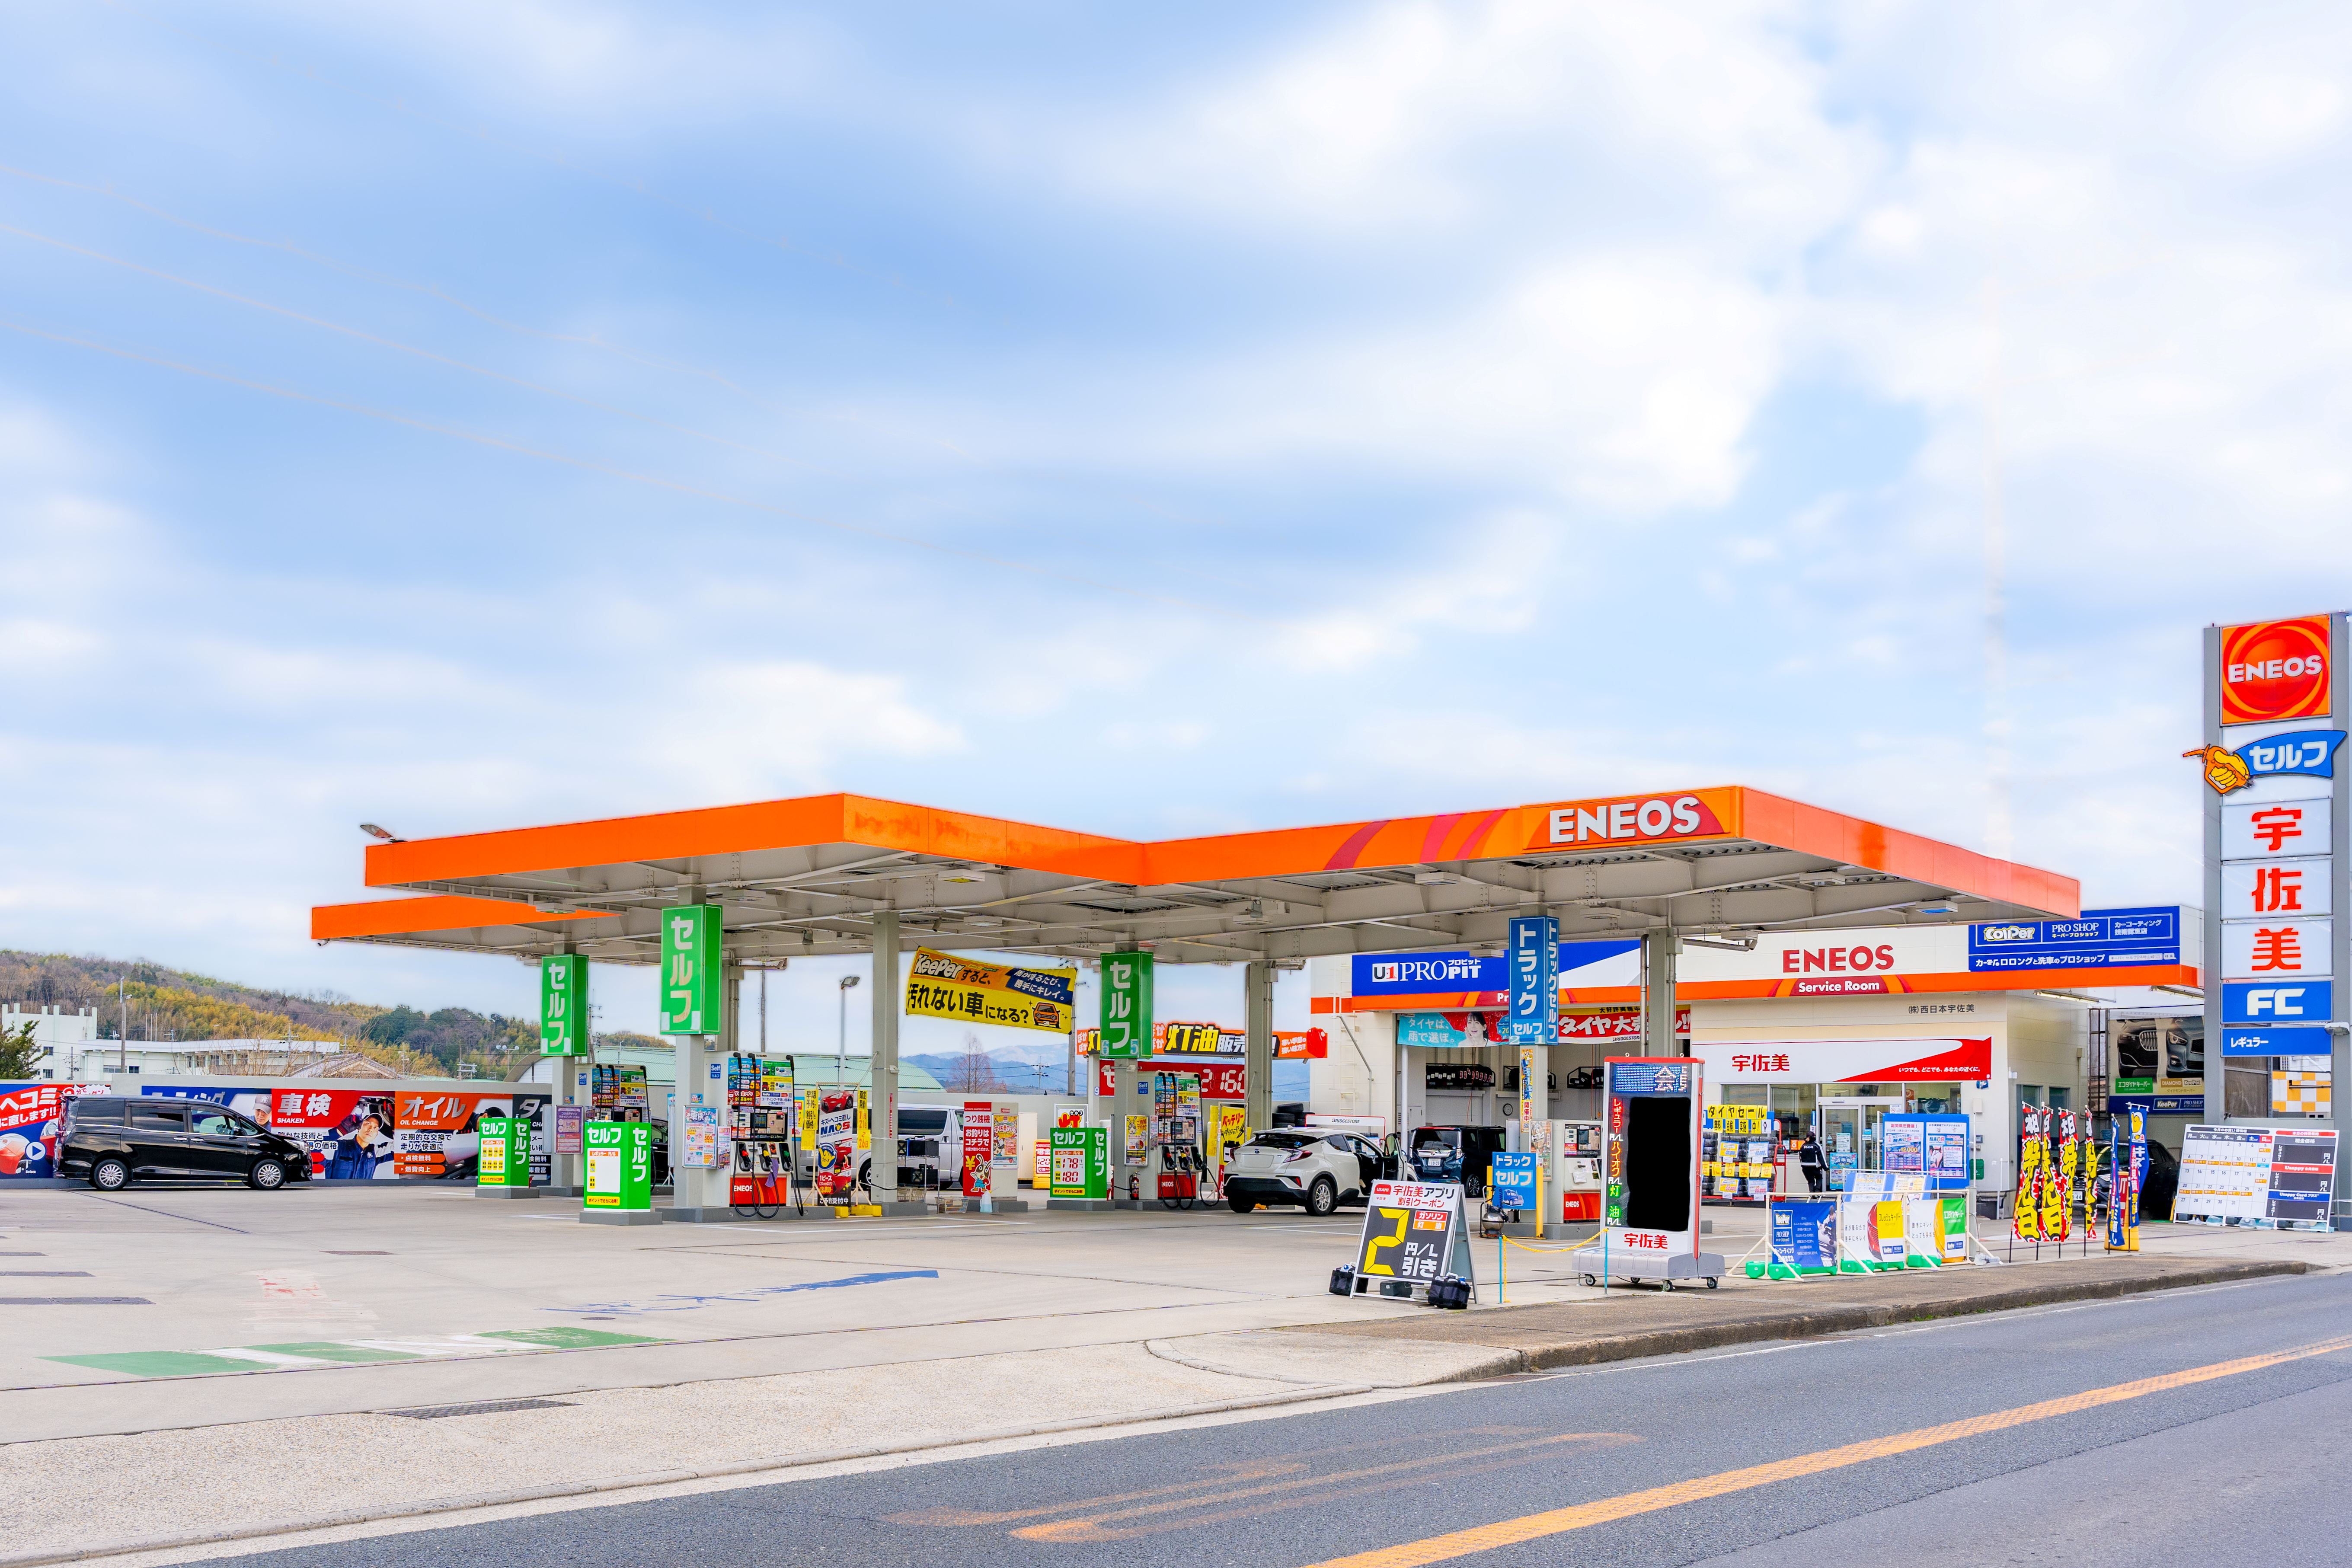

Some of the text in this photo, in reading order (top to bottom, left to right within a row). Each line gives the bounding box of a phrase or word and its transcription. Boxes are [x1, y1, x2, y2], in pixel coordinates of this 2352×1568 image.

[2228, 655, 2322, 683] ENEOS
[2249, 741, 2327, 771] セルフ
[1550, 797, 1699, 843] ENEOS
[2251, 807, 2302, 971] 宇佐美
[2052, 923, 2099, 932] PRO SHOP
[2115, 920, 2162, 928] カーコーティング
[914, 953, 965, 979] KeePer
[1783, 945, 1894, 973] ENEOS
[670, 916, 693, 1024] セルフ
[1014, 969, 1061, 987] 雨が降るたび、
[1400, 960, 1447, 981] PRO
[1448, 966, 1482, 979] PIT
[1518, 924, 1537, 1016] トラック
[1548, 922, 1557, 1039] トラックセルフ
[1799, 980, 1879, 993] Service Room
[1014, 979, 1064, 1001] 勝手にキレイ。
[548, 963, 566, 1048] セルフ
[1109, 961, 1131, 1049] セルフ
[2247, 988, 2306, 1016] FC
[1408, 1018, 1449, 1029] タイヤは、
[1512, 1023, 1542, 1035] セルフ
[1408, 1030, 1454, 1043] 雨で選ぼ。
[2231, 1037, 2269, 1048] レギュラー
[1102, 1040, 1109, 1055] 6
[1131, 1039, 1138, 1054] 5
[1732, 1054, 1790, 1072] 宇佐美
[0, 1088, 58, 1111] ヘコミ
[278, 1093, 332, 1116] 車検
[401, 1096, 466, 1118] オイル
[965, 1115, 990, 1123] つり銭機
[1222, 1113, 1244, 1127] バッテリー
[1613, 1098, 1622, 1133] レギュラー
[1708, 1106, 1765, 1118] タイヤセール
[401, 1133, 451, 1141] 定期的な交換で
[481, 1122, 506, 1135] セルフ
[588, 1127, 621, 1143] セルフ
[965, 1129, 989, 1137] お釣りは
[514, 1122, 527, 1165] セルフ
[1053, 1132, 1086, 1145] セルフ
[632, 1127, 647, 1182] セルフ
[1094, 1132, 1104, 1176] セルフ
[1496, 1155, 1531, 1166] トラック
[1611, 1142, 1621, 1177] ハイオク
[1062, 1158, 1079, 1169] 178
[1062, 1171, 1079, 1182] 180
[1496, 1171, 1532, 1186] セルフ
[1393, 1185, 1455, 1199] 宇佐美アプリ
[1398, 1197, 1444, 1208] 割引クーポン
[1775, 1213, 1790, 1225] KeePer
[1363, 1208, 1410, 1275] 2
[1624, 1233, 1668, 1249] 宇佐美
[1402, 1257, 1438, 1278] 引き
